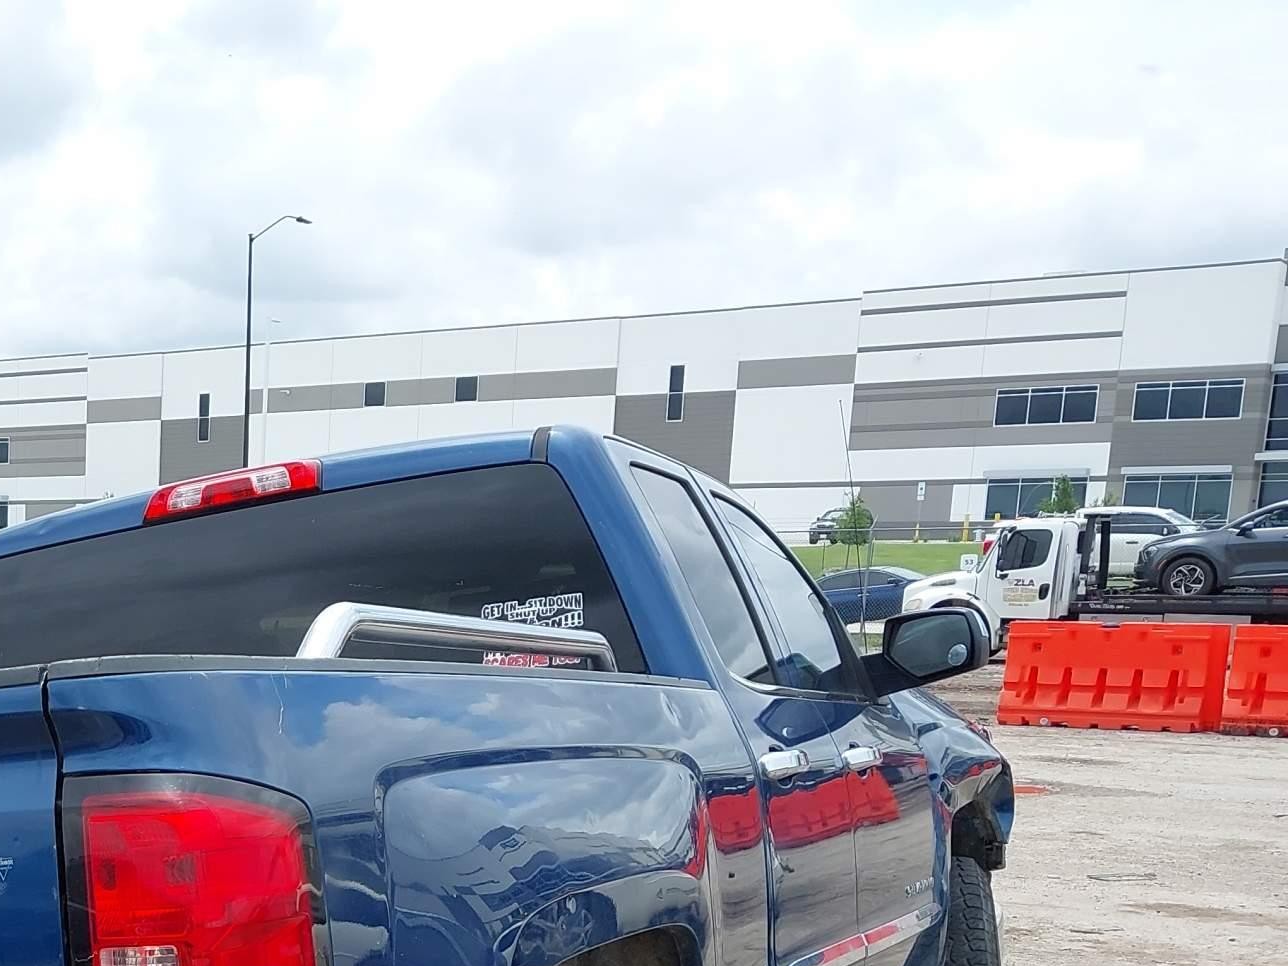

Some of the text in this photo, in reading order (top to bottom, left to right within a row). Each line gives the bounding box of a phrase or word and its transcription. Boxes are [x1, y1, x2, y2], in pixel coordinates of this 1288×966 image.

[1014, 578, 1035, 587] ZLA
[481, 603, 503, 619] GET
[546, 592, 583, 610] DOWN
[508, 606, 557, 620] SHUT UP
